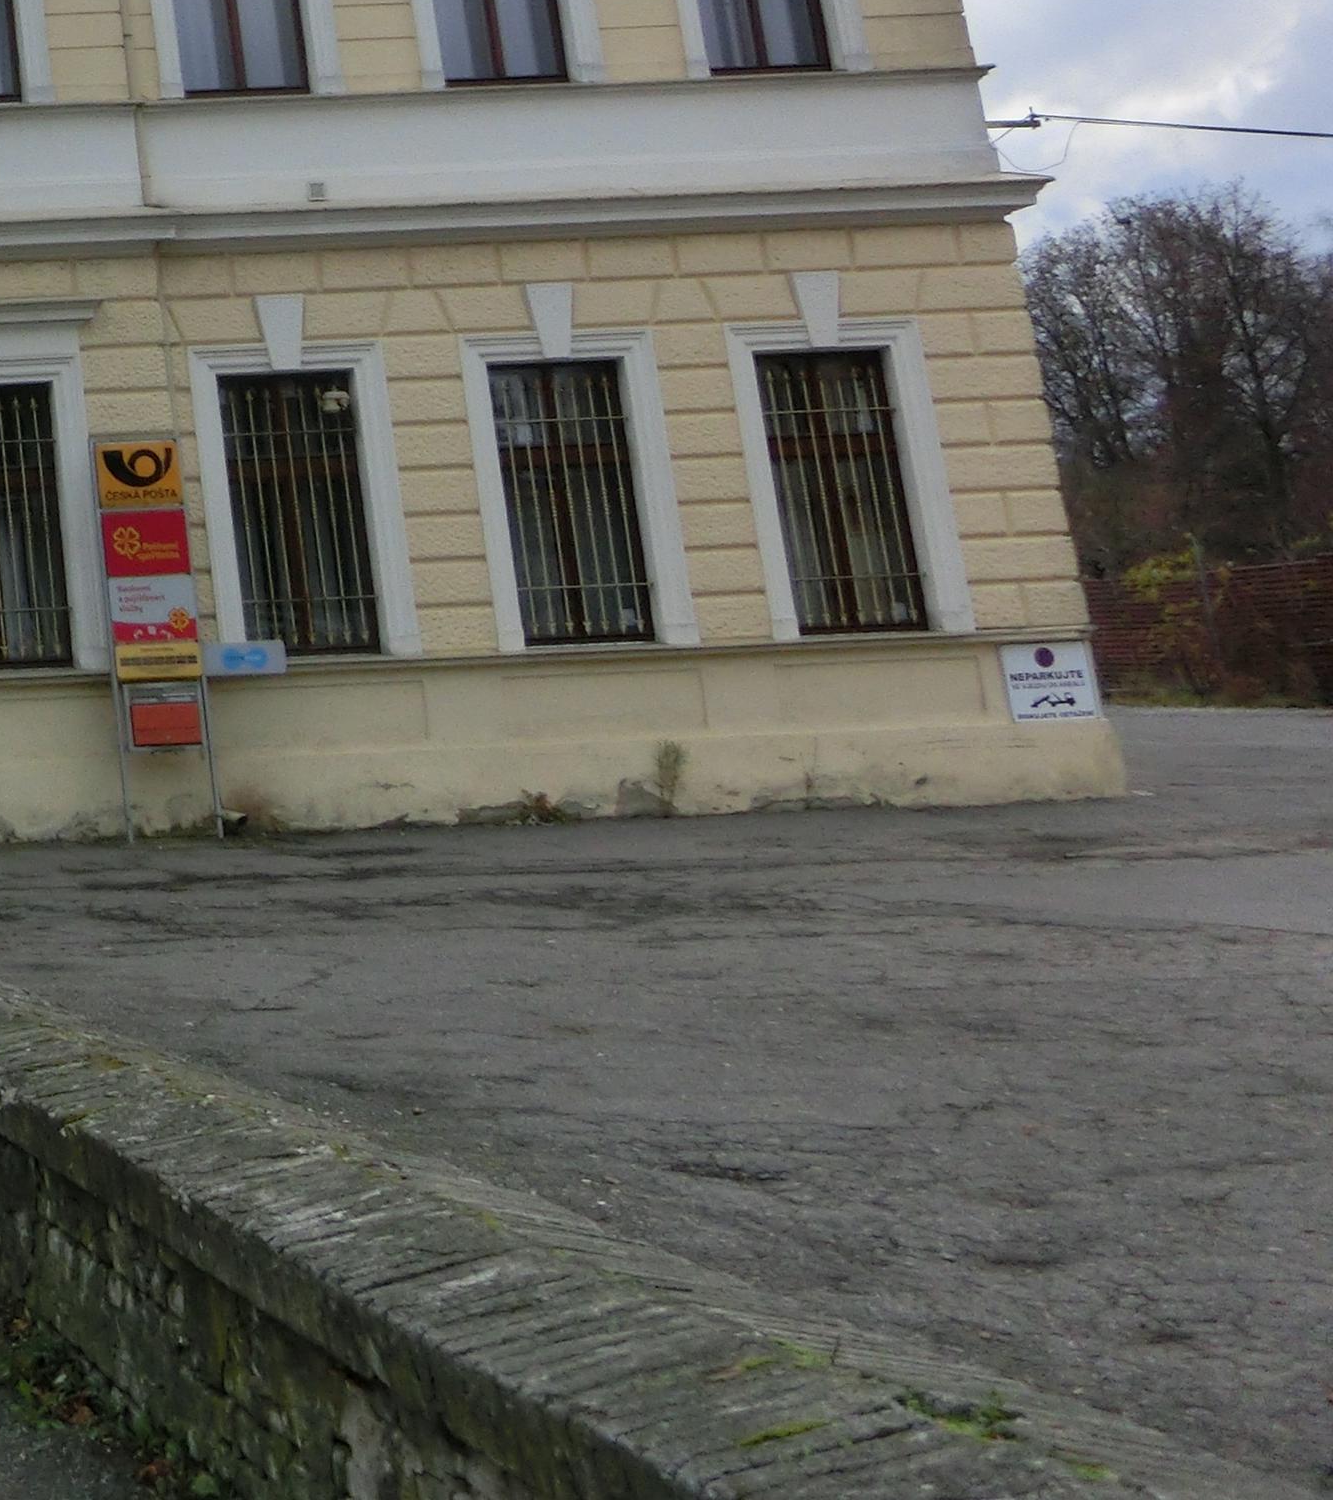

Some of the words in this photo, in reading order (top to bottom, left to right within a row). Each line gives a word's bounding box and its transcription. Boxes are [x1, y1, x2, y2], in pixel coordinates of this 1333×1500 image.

[105, 489, 142, 500] ČESKÁ
[142, 487, 178, 499] POŠTA
[1010, 669, 1084, 681] NEPARKUJTE
